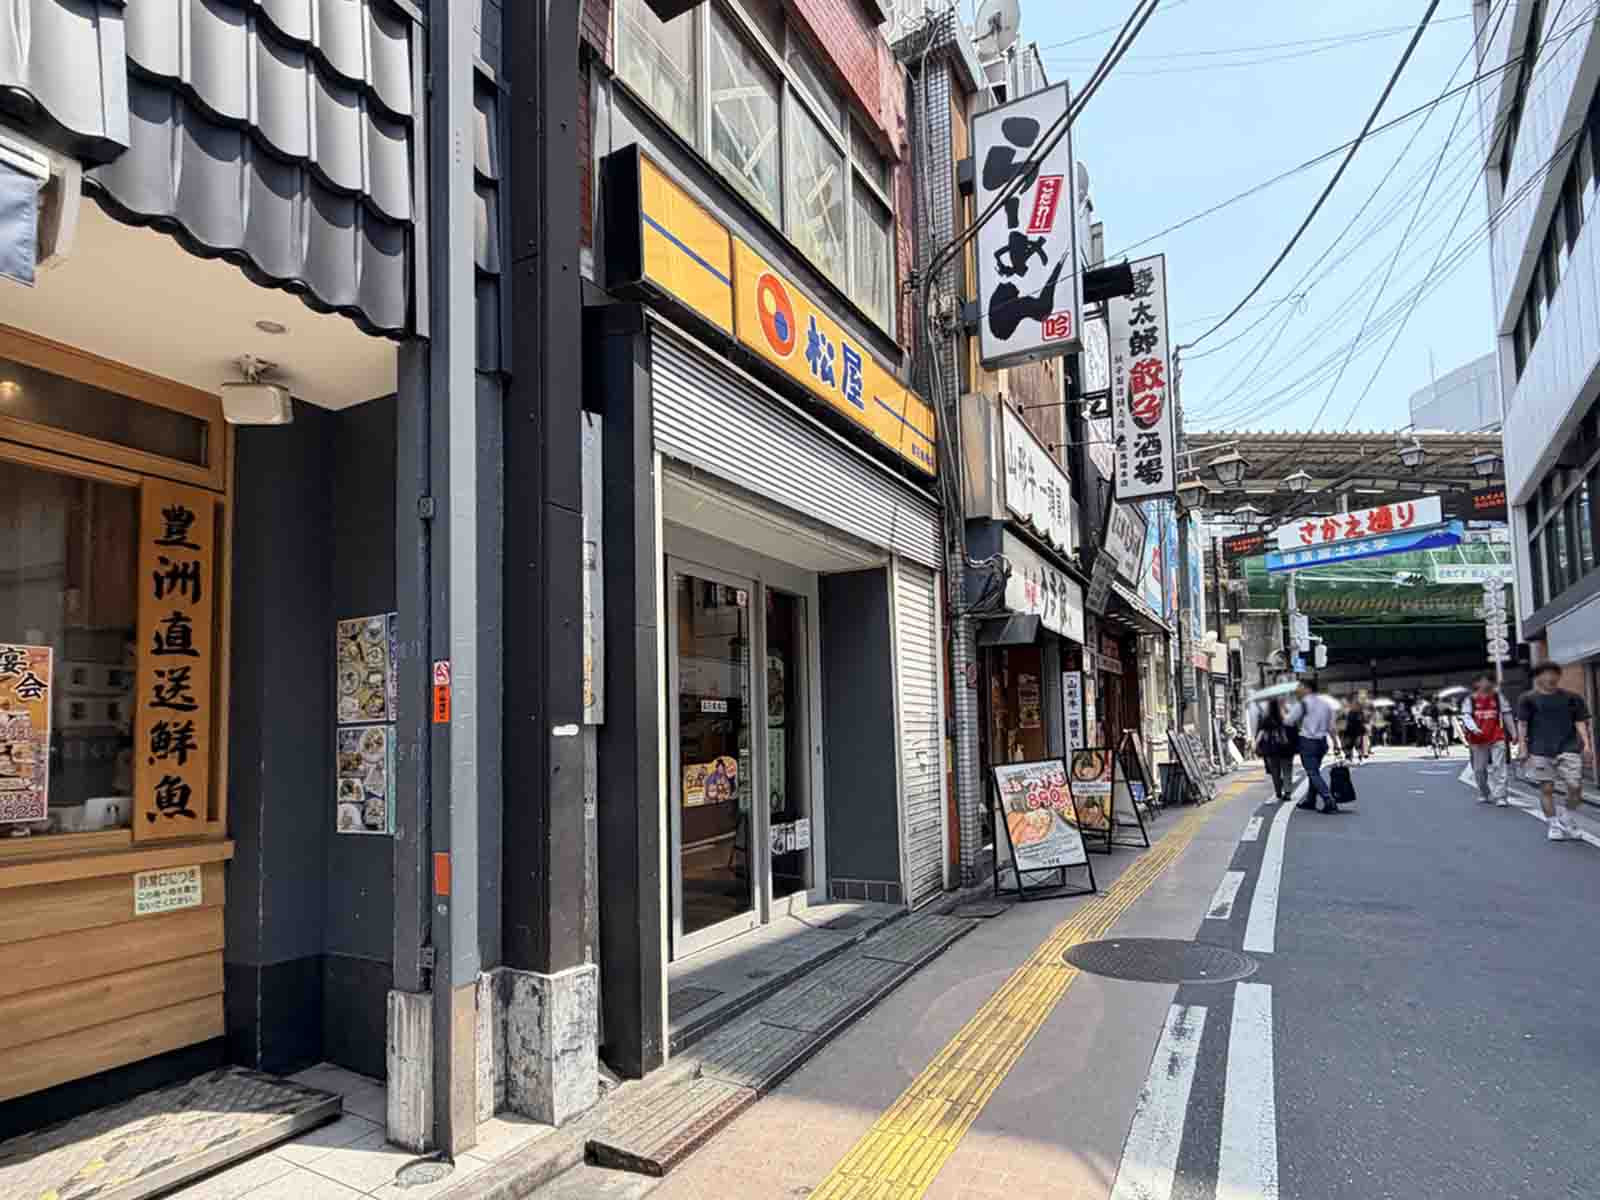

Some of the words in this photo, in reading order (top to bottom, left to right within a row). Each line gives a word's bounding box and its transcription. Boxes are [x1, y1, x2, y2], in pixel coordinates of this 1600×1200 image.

[983, 115, 1070, 340] らーめん
[1035, 178, 1057, 230] こだわり
[805, 314, 865, 411] 松屋
[1298, 503, 1416, 545] さかえ通り
[0, 647, 49, 699] 宴会
[146, 505, 202, 823] 豊洲直送鮮魚
